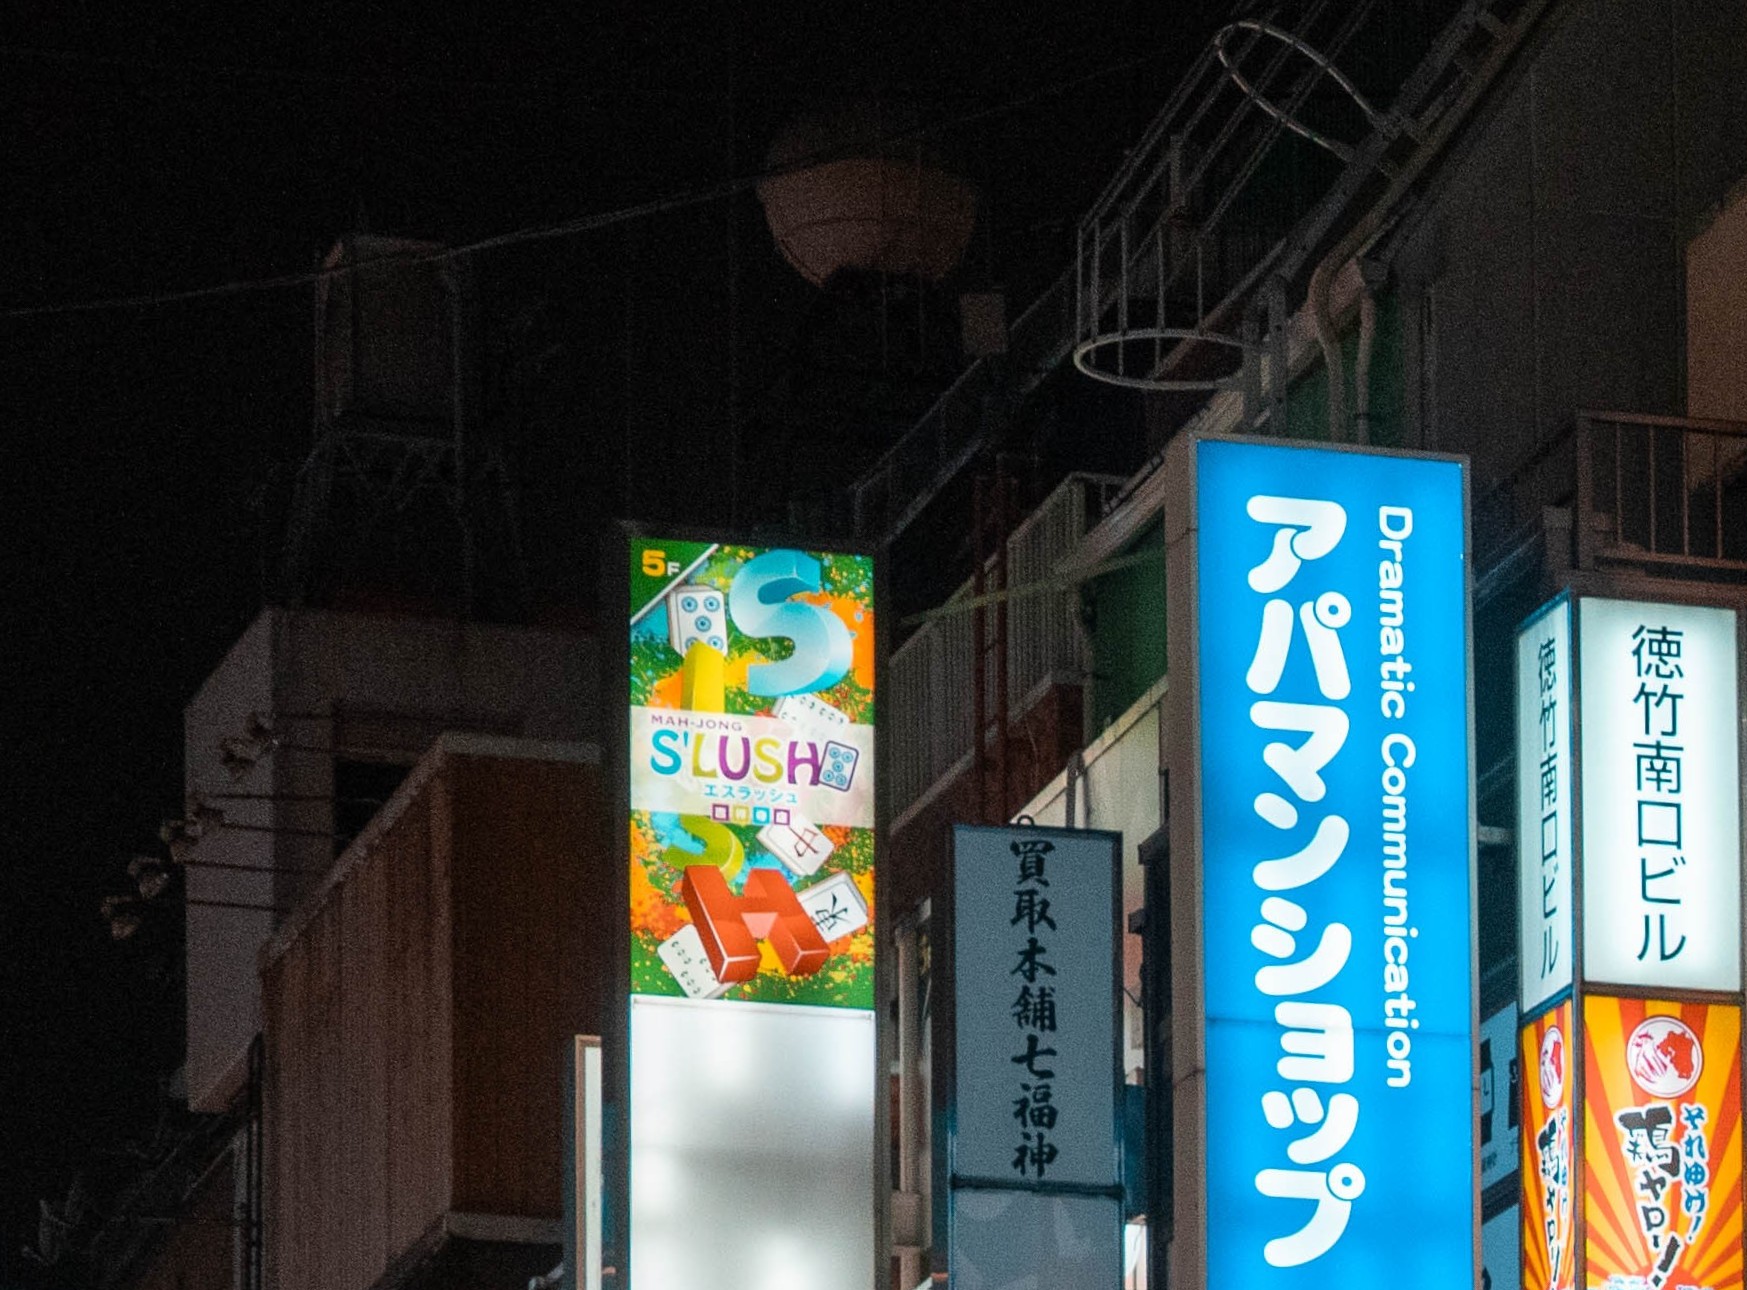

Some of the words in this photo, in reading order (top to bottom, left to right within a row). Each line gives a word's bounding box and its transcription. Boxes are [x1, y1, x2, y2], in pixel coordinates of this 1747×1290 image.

[641, 549, 681, 578] 5F
[1379, 506, 1417, 719] Dramatic
[650, 728, 822, 787] S'LUSH
[651, 713, 743, 732] MAH-JONG
[703, 784, 799, 804] エスラッシュ
[1536, 636, 1560, 982] 徳竹南口ビル
[1631, 624, 1688, 965] 徳竹南口ビル
[1006, 836, 1061, 1177] 買取本舗七福神
[1246, 494, 1367, 1269] アパマンショップ
[1380, 732, 1420, 1089] Communication
